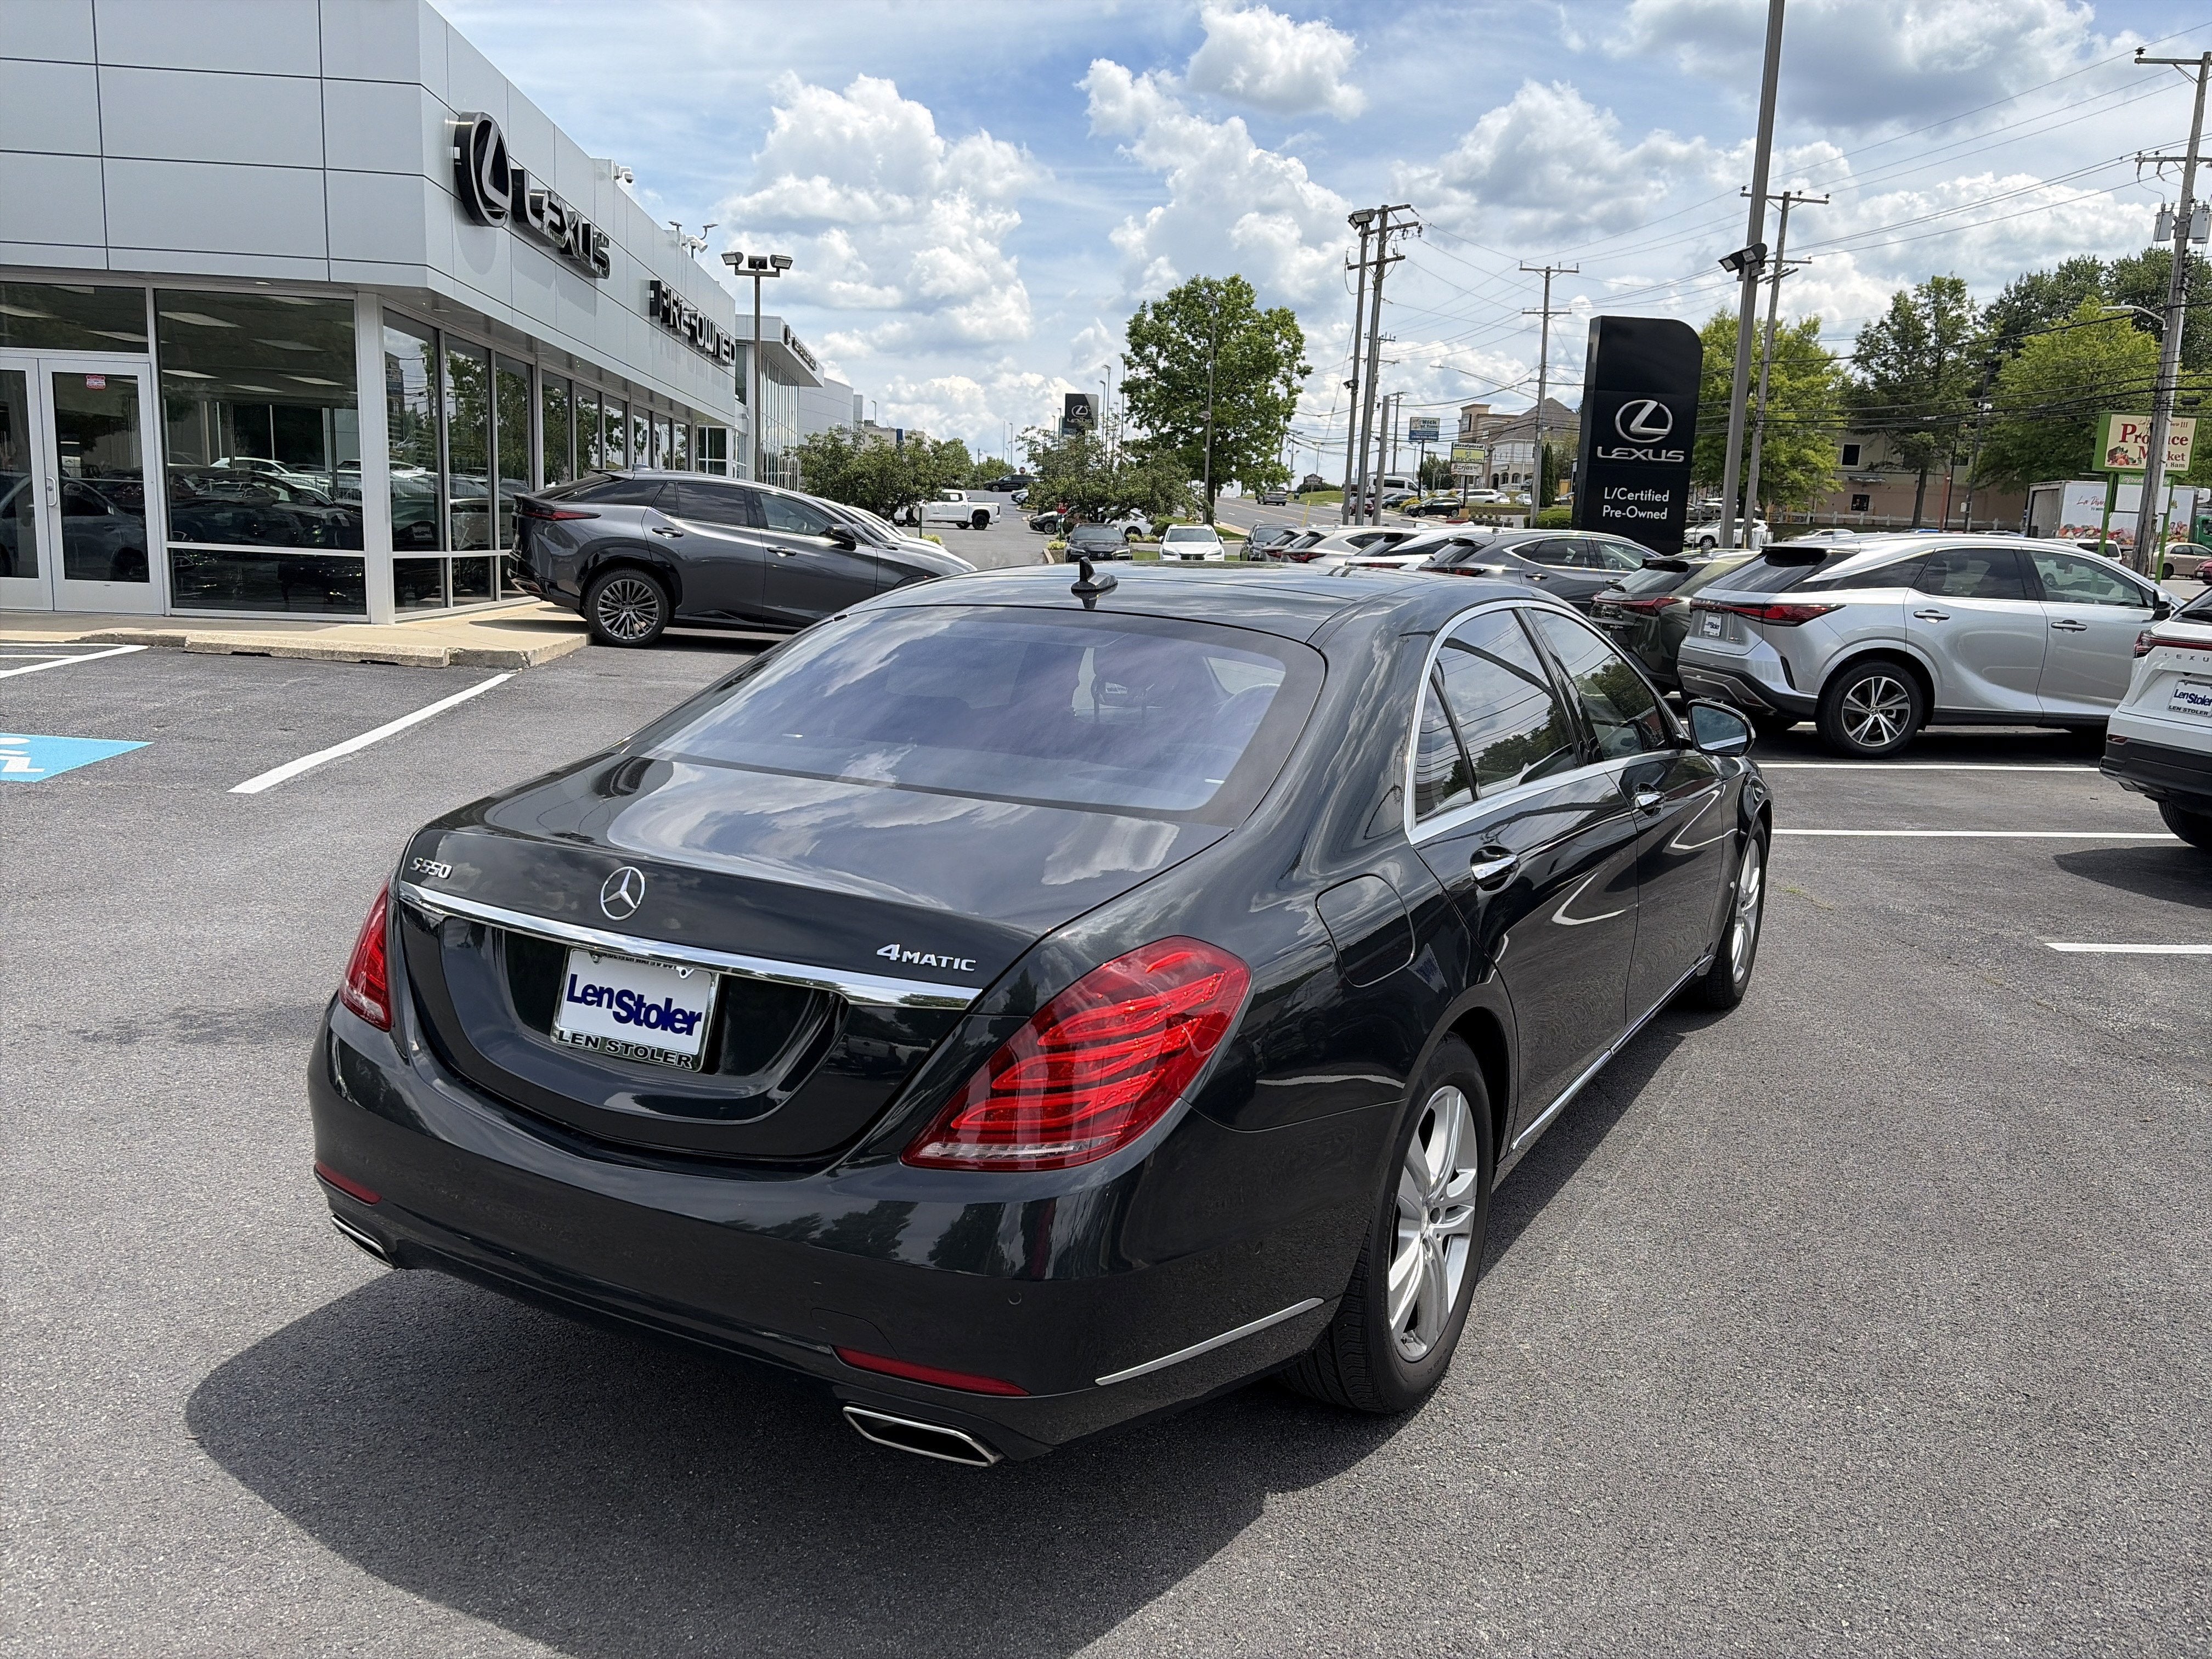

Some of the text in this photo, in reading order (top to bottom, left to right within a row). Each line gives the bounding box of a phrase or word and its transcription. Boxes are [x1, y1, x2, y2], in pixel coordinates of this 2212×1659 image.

[511, 168, 611, 280] LEXUS
[650, 280, 737, 367] PRE-OWNED
[2119, 423, 2189, 445] Proce
[1596, 446, 1685, 462] LEXUS
[2137, 445, 2186, 461] Mket
[1604, 487, 1670, 502] L/Certified
[1602, 505, 1668, 520] Pre-Owned
[2183, 707, 2209, 715] STOLER
[876, 943, 977, 972] 4MATIC
[557, 1030, 693, 1070] LEN STOLER
